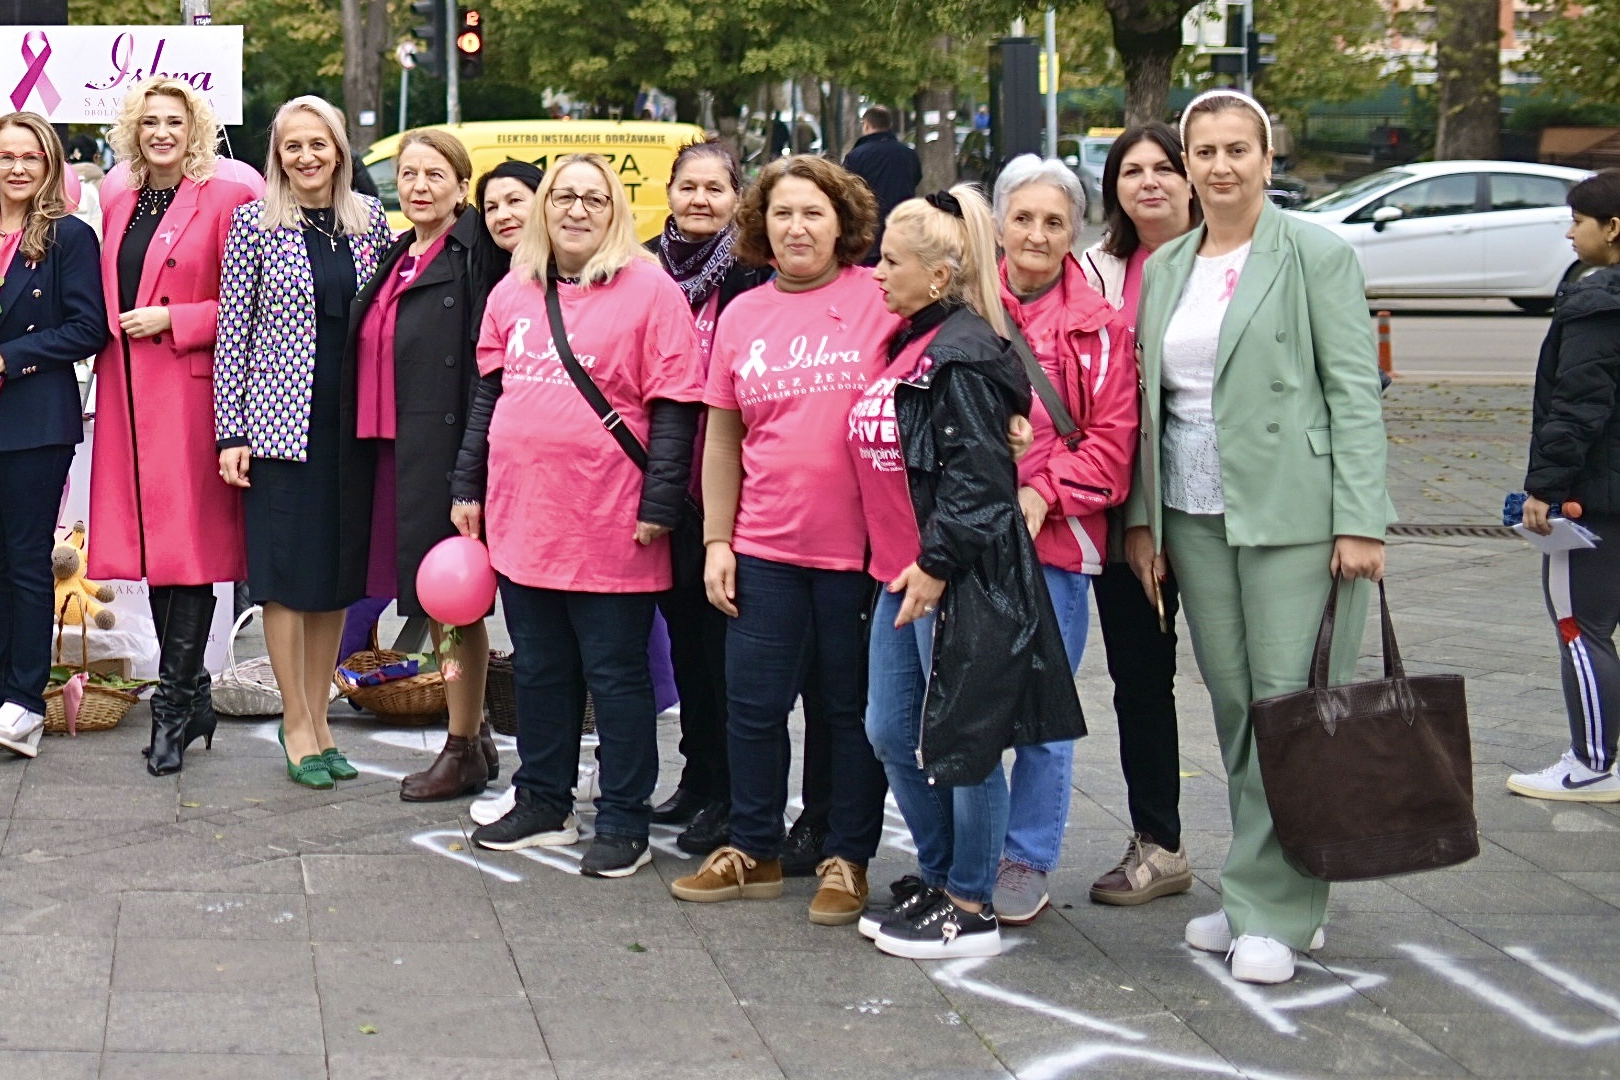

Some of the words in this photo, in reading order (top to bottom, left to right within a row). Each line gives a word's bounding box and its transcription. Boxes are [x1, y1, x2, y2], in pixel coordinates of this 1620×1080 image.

[84, 98, 121, 107] SAV
[497, 134, 538, 144] ELEKTRO
[541, 134, 602, 144] INSTALACIJE
[771, 335, 861, 372] Iskra
[740, 377, 802, 399] SAVEZ
[815, 372, 867, 384] ŽENA
